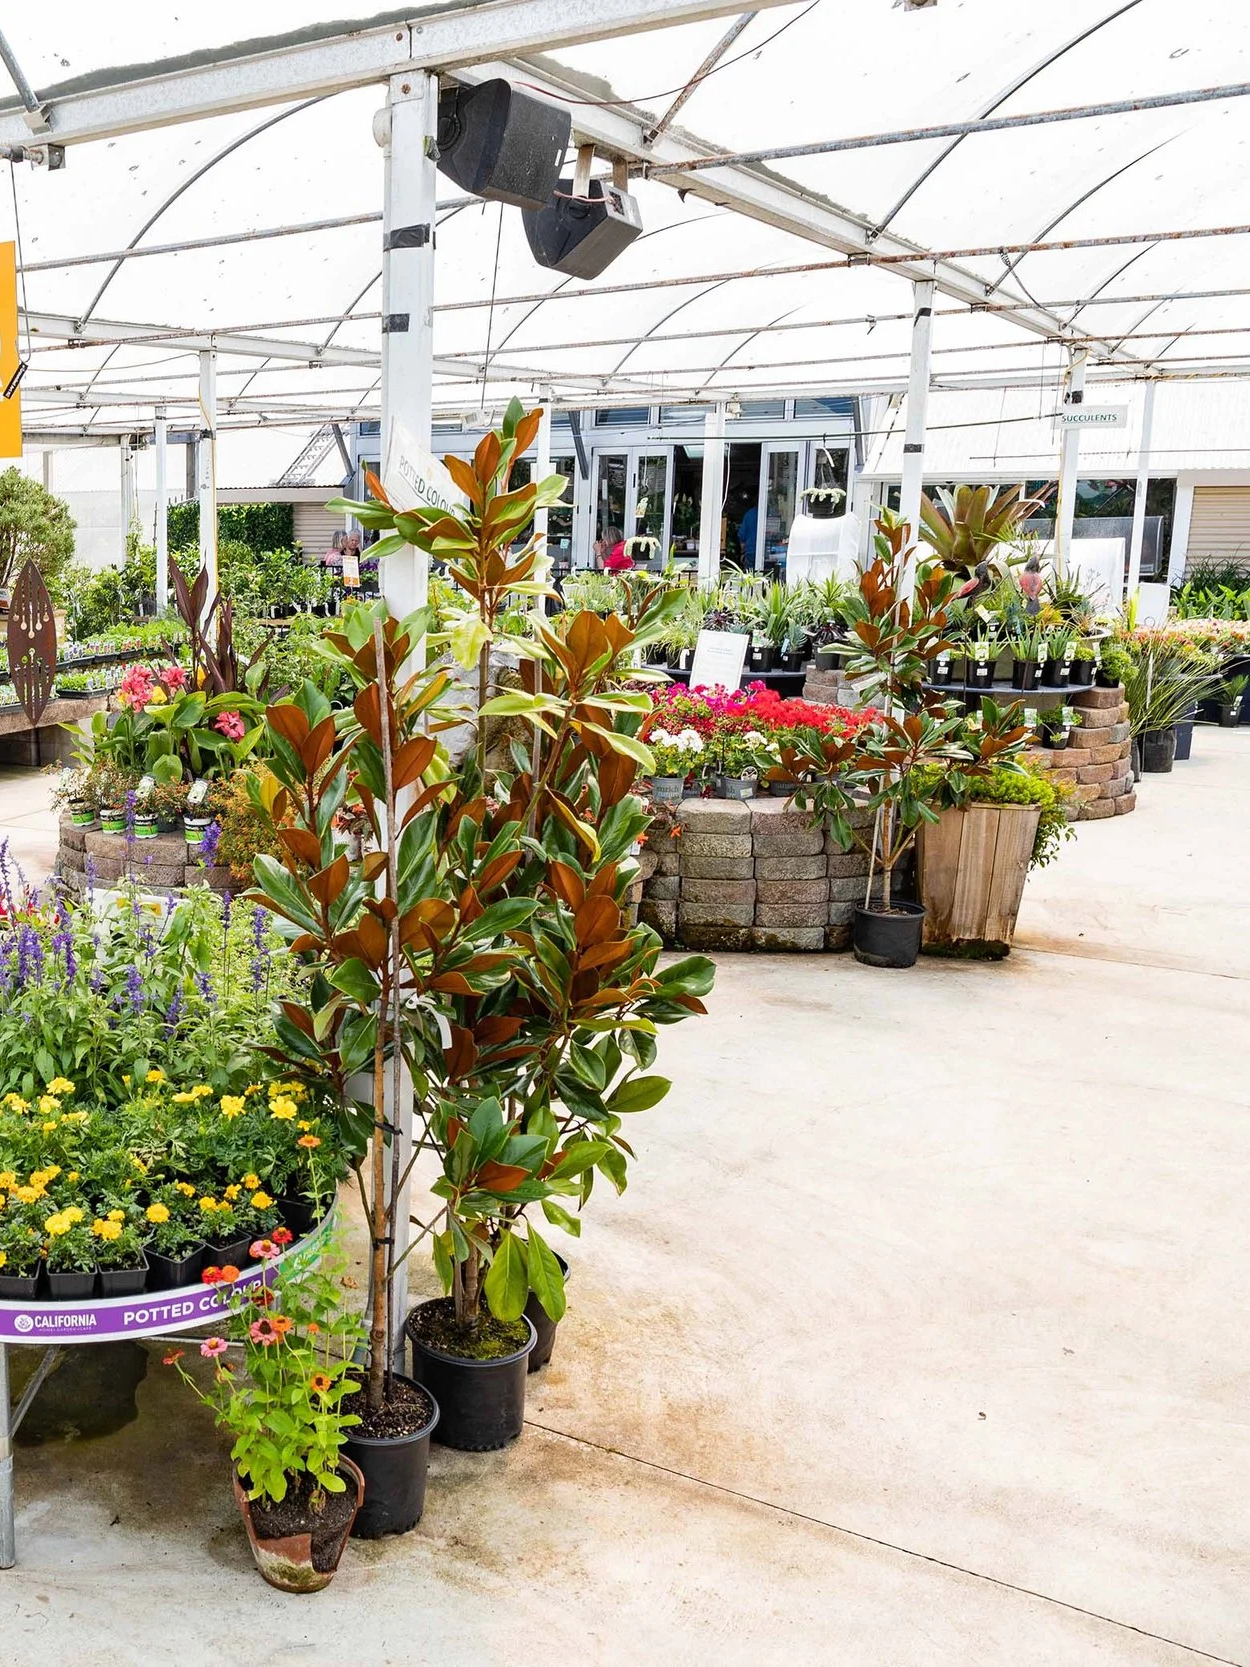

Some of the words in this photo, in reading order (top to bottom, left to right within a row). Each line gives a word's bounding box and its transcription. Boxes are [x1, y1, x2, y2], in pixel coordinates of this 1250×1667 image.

[1061, 413, 1117, 422] SUCCULENTS
[399, 455, 426, 494] POTTED
[34, 1314, 97, 1329] CALIFORNIA
[123, 1301, 194, 1326] POTTED
[199, 1279, 262, 1311] COLOR
